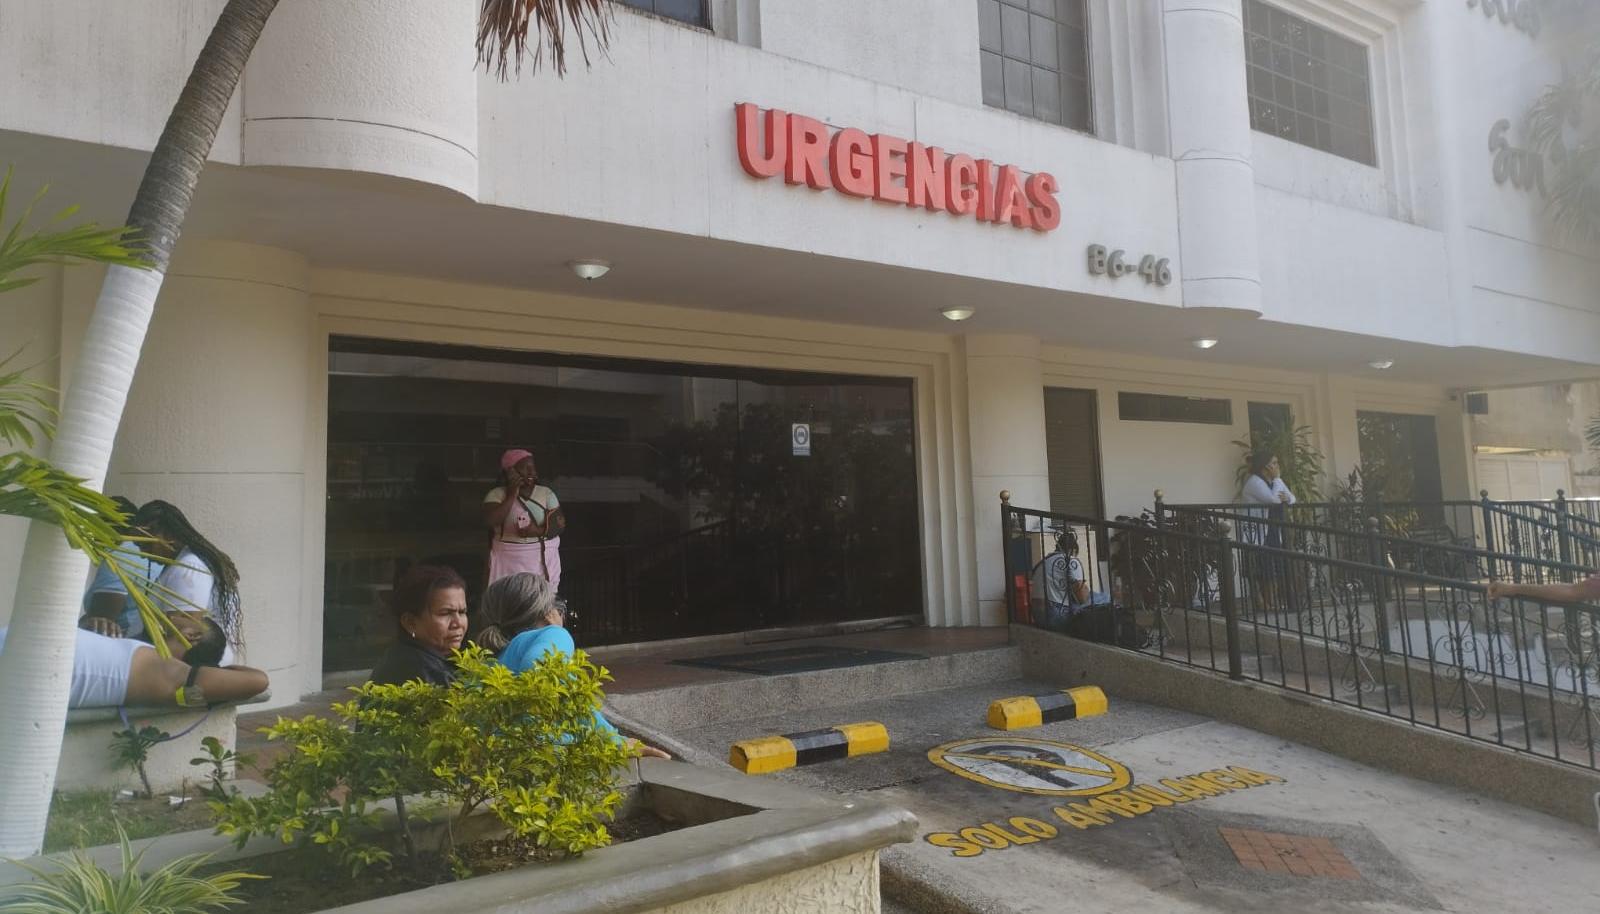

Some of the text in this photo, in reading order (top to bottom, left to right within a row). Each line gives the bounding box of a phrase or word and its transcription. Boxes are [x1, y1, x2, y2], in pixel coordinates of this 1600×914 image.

[735, 102, 1061, 231] URGENCIAS
[926, 766, 1286, 857] SOLO AMBULANCIA
